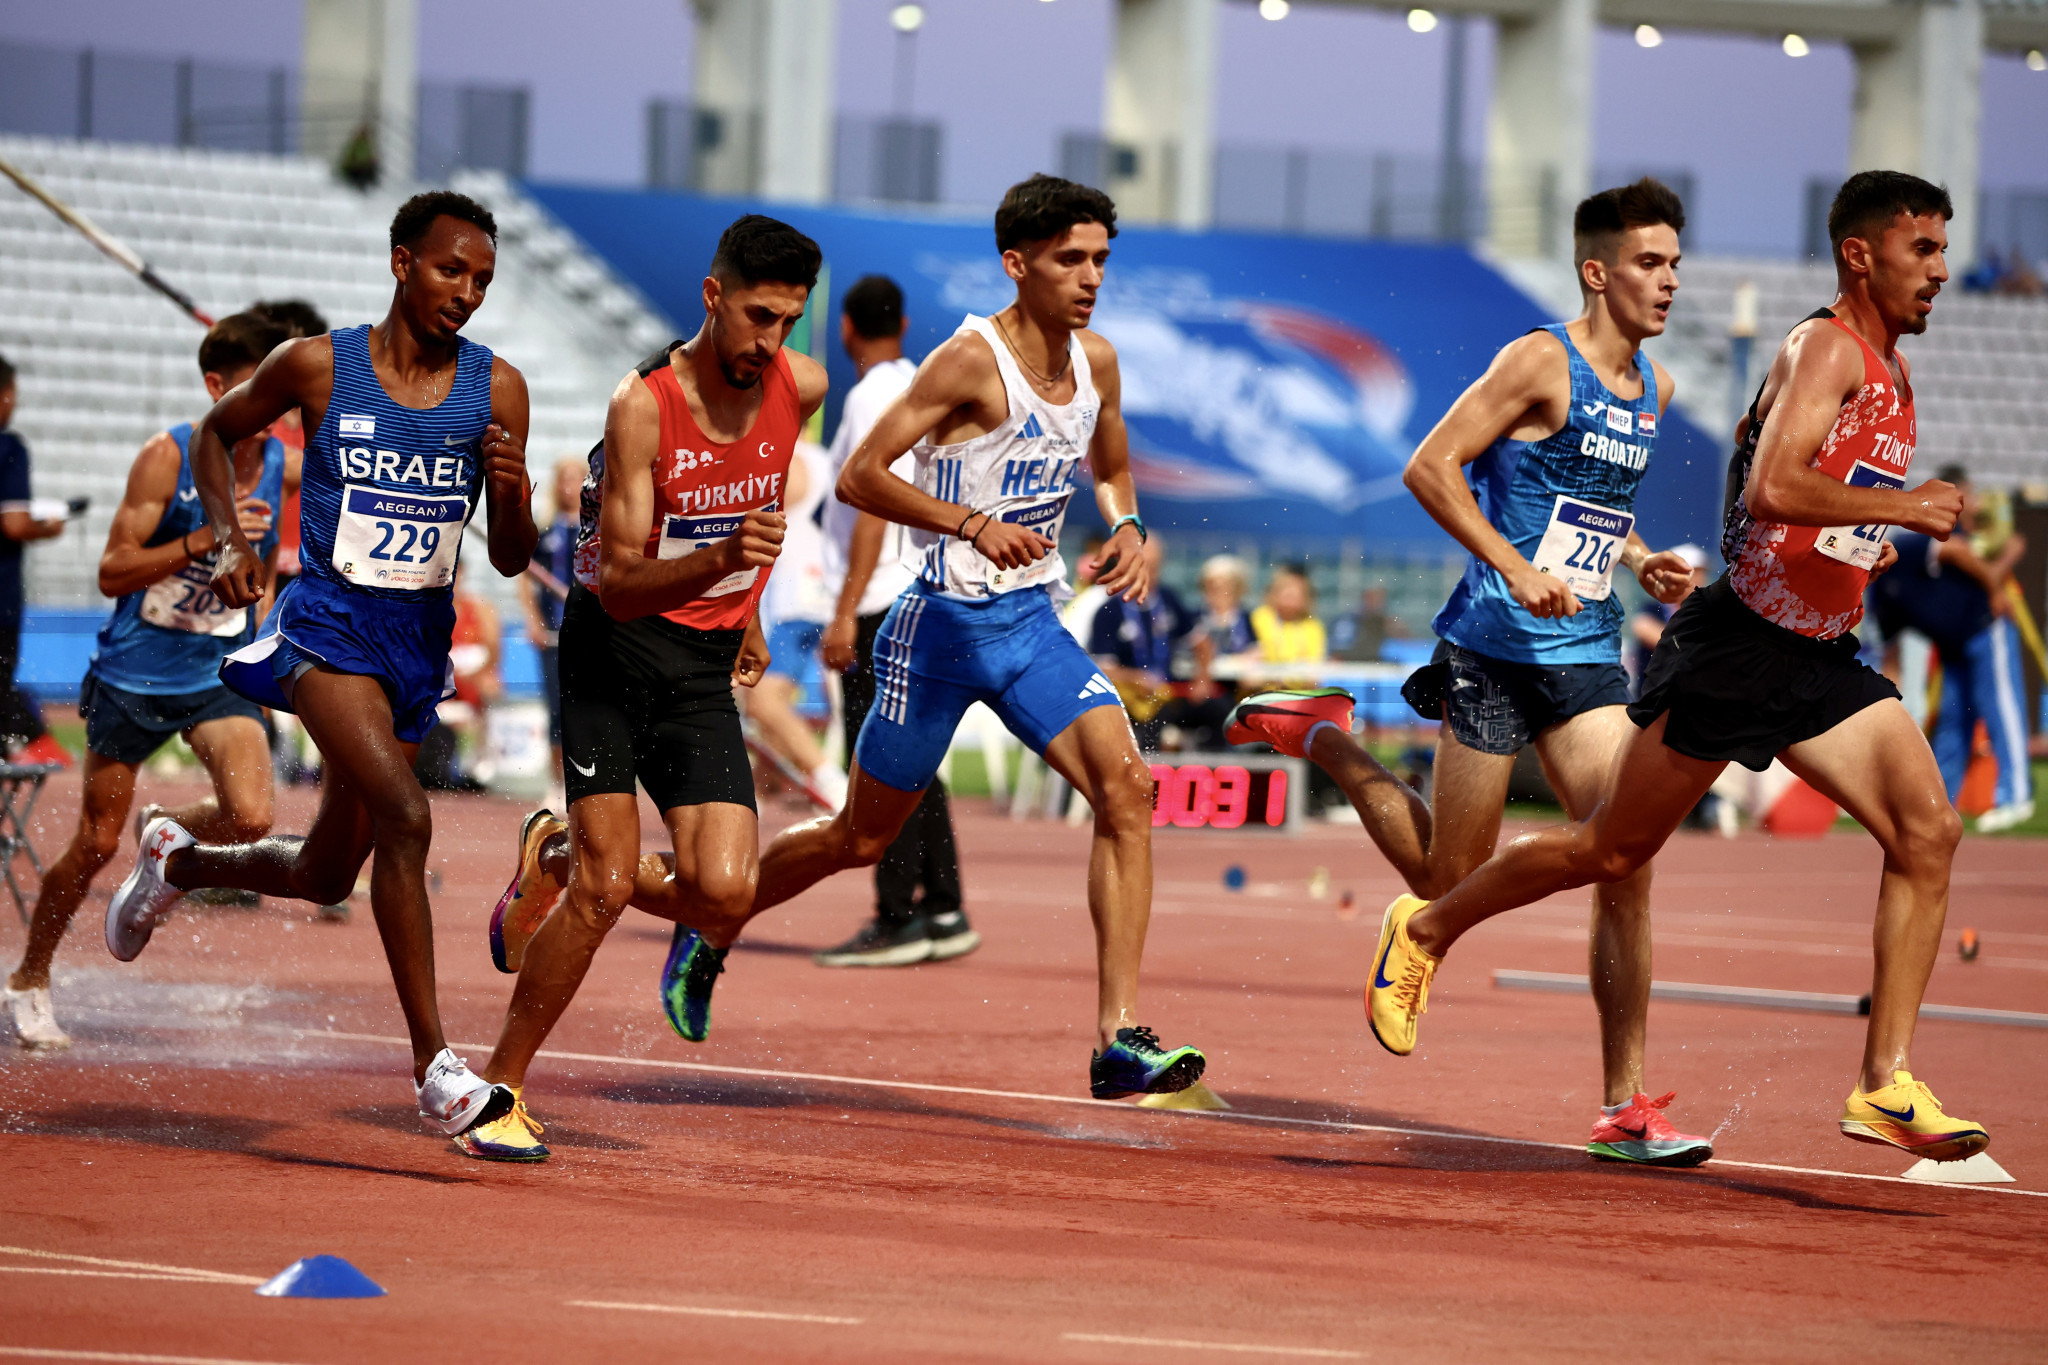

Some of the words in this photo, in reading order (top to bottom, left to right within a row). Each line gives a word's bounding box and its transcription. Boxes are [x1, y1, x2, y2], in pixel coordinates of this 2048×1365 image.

[1614, 414, 1629, 428] HEP
[338, 447, 469, 487] ISRAEL
[1580, 431, 1649, 471] CROATIA
[677, 472, 782, 513] TÜRKİYE
[1000, 457, 1081, 496] HELLA
[373, 500, 437, 517] AEGEAN
[693, 522, 740, 534] AEGEA
[1016, 507, 1055, 523] AEGEAN
[1577, 512, 1617, 531] AEGEAN
[368, 521, 441, 564] 229
[1564, 531, 1615, 575] 226
